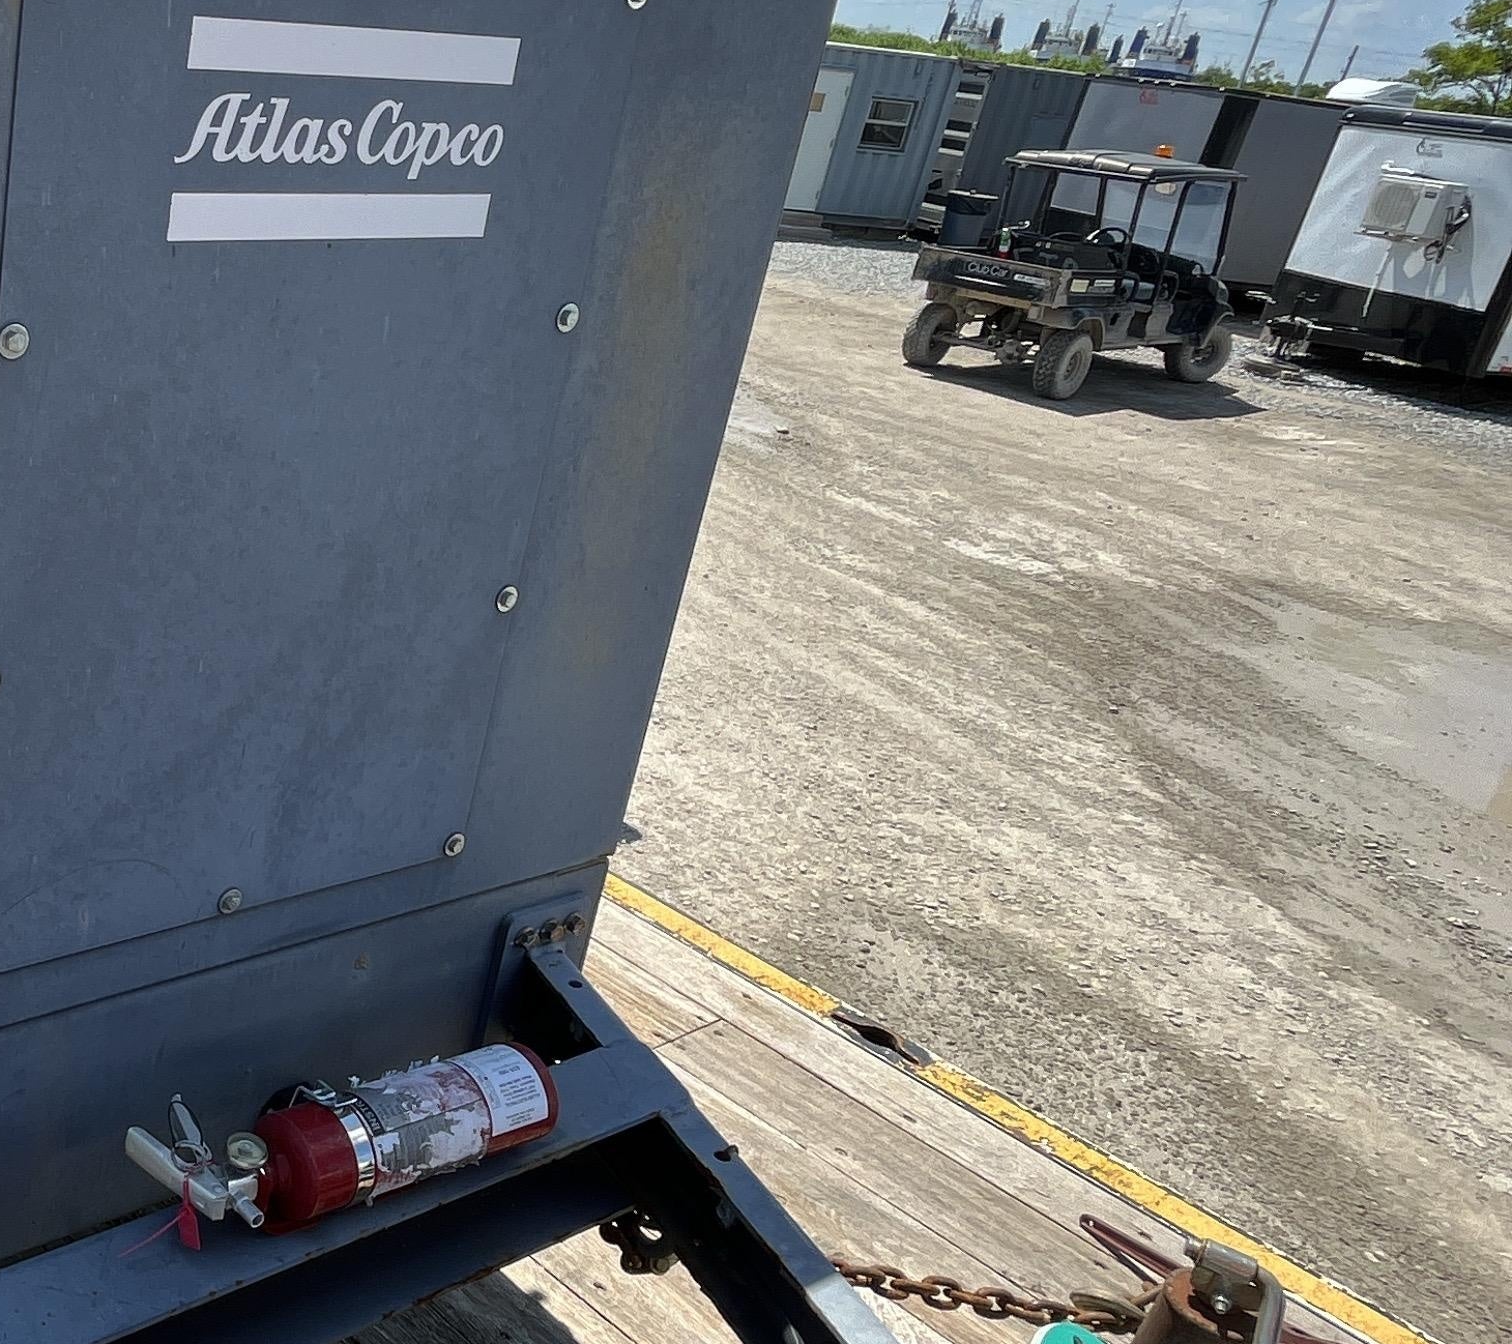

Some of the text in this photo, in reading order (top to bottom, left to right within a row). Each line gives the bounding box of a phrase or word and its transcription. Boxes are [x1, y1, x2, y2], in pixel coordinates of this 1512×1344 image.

[174, 92, 505, 180] Atlas Copco
[967, 261, 1009, 278] Club Car
